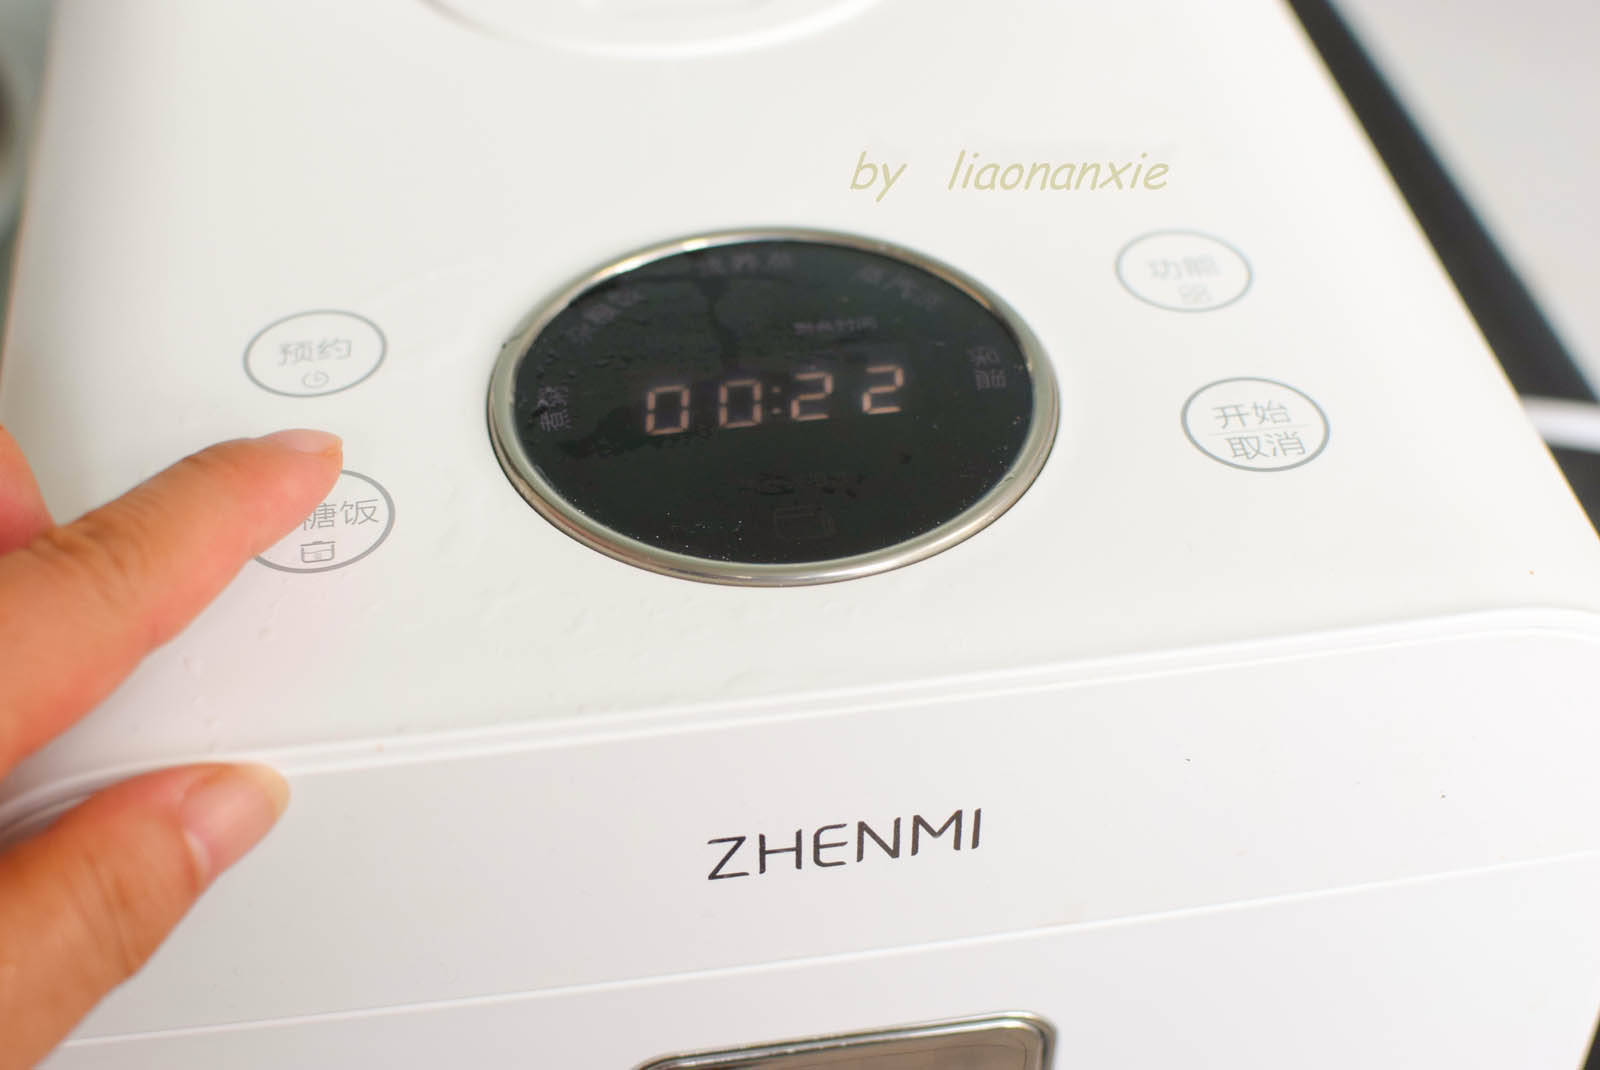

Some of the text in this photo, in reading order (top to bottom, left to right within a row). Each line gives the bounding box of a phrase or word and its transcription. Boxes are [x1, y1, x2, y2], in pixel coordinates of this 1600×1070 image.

[278, 337, 352, 367] 预约
[646, 365, 904, 436] 00:22
[1212, 400, 1291, 429] 开始
[1224, 432, 1306, 460] 取消
[303, 498, 379, 531] 糖饭
[707, 808, 981, 880] ZHENMI
